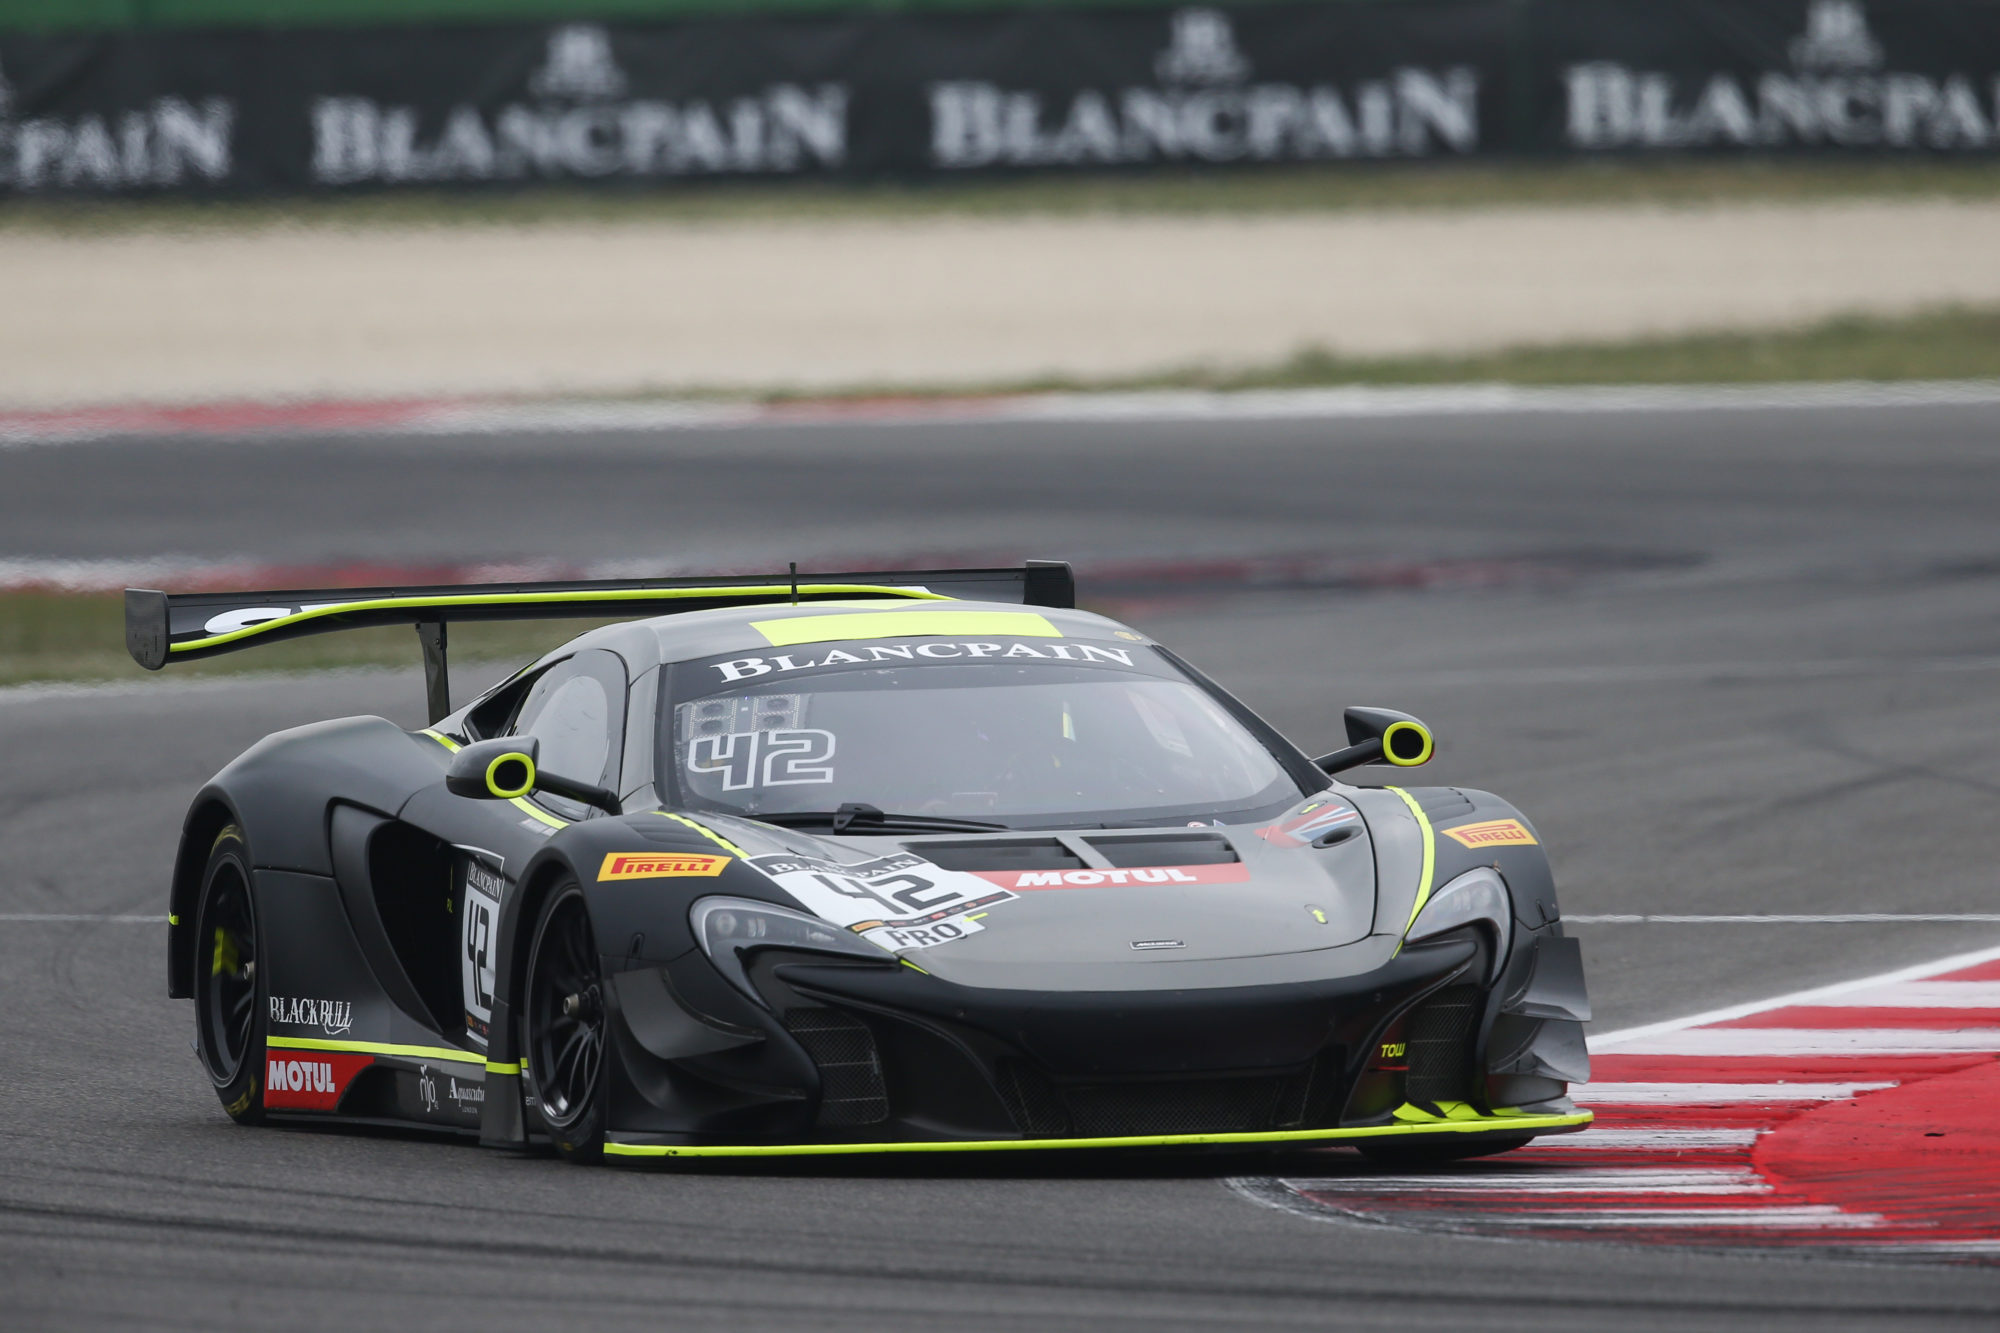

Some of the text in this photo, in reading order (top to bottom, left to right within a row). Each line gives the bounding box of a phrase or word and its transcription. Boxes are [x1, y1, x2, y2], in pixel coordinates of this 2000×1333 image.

[311, 83, 848, 183] BLANCPAIN
[932, 66, 1477, 166] BLANCPAIN
[0, 97, 231, 186] PAIN
[710, 642, 1134, 683] BLANCPAIN
[688, 728, 836, 792] 42
[1455, 824, 1526, 843] PIRELLI
[610, 856, 716, 875] PIRELLI
[1016, 869, 1197, 887] MOTUL
[810, 874, 965, 915] 42
[885, 922, 963, 947] PRO
[269, 996, 353, 1035] BLACK BULL
[1381, 1042, 1406, 1058] TOW
[268, 1060, 336, 1093] MOTUL
